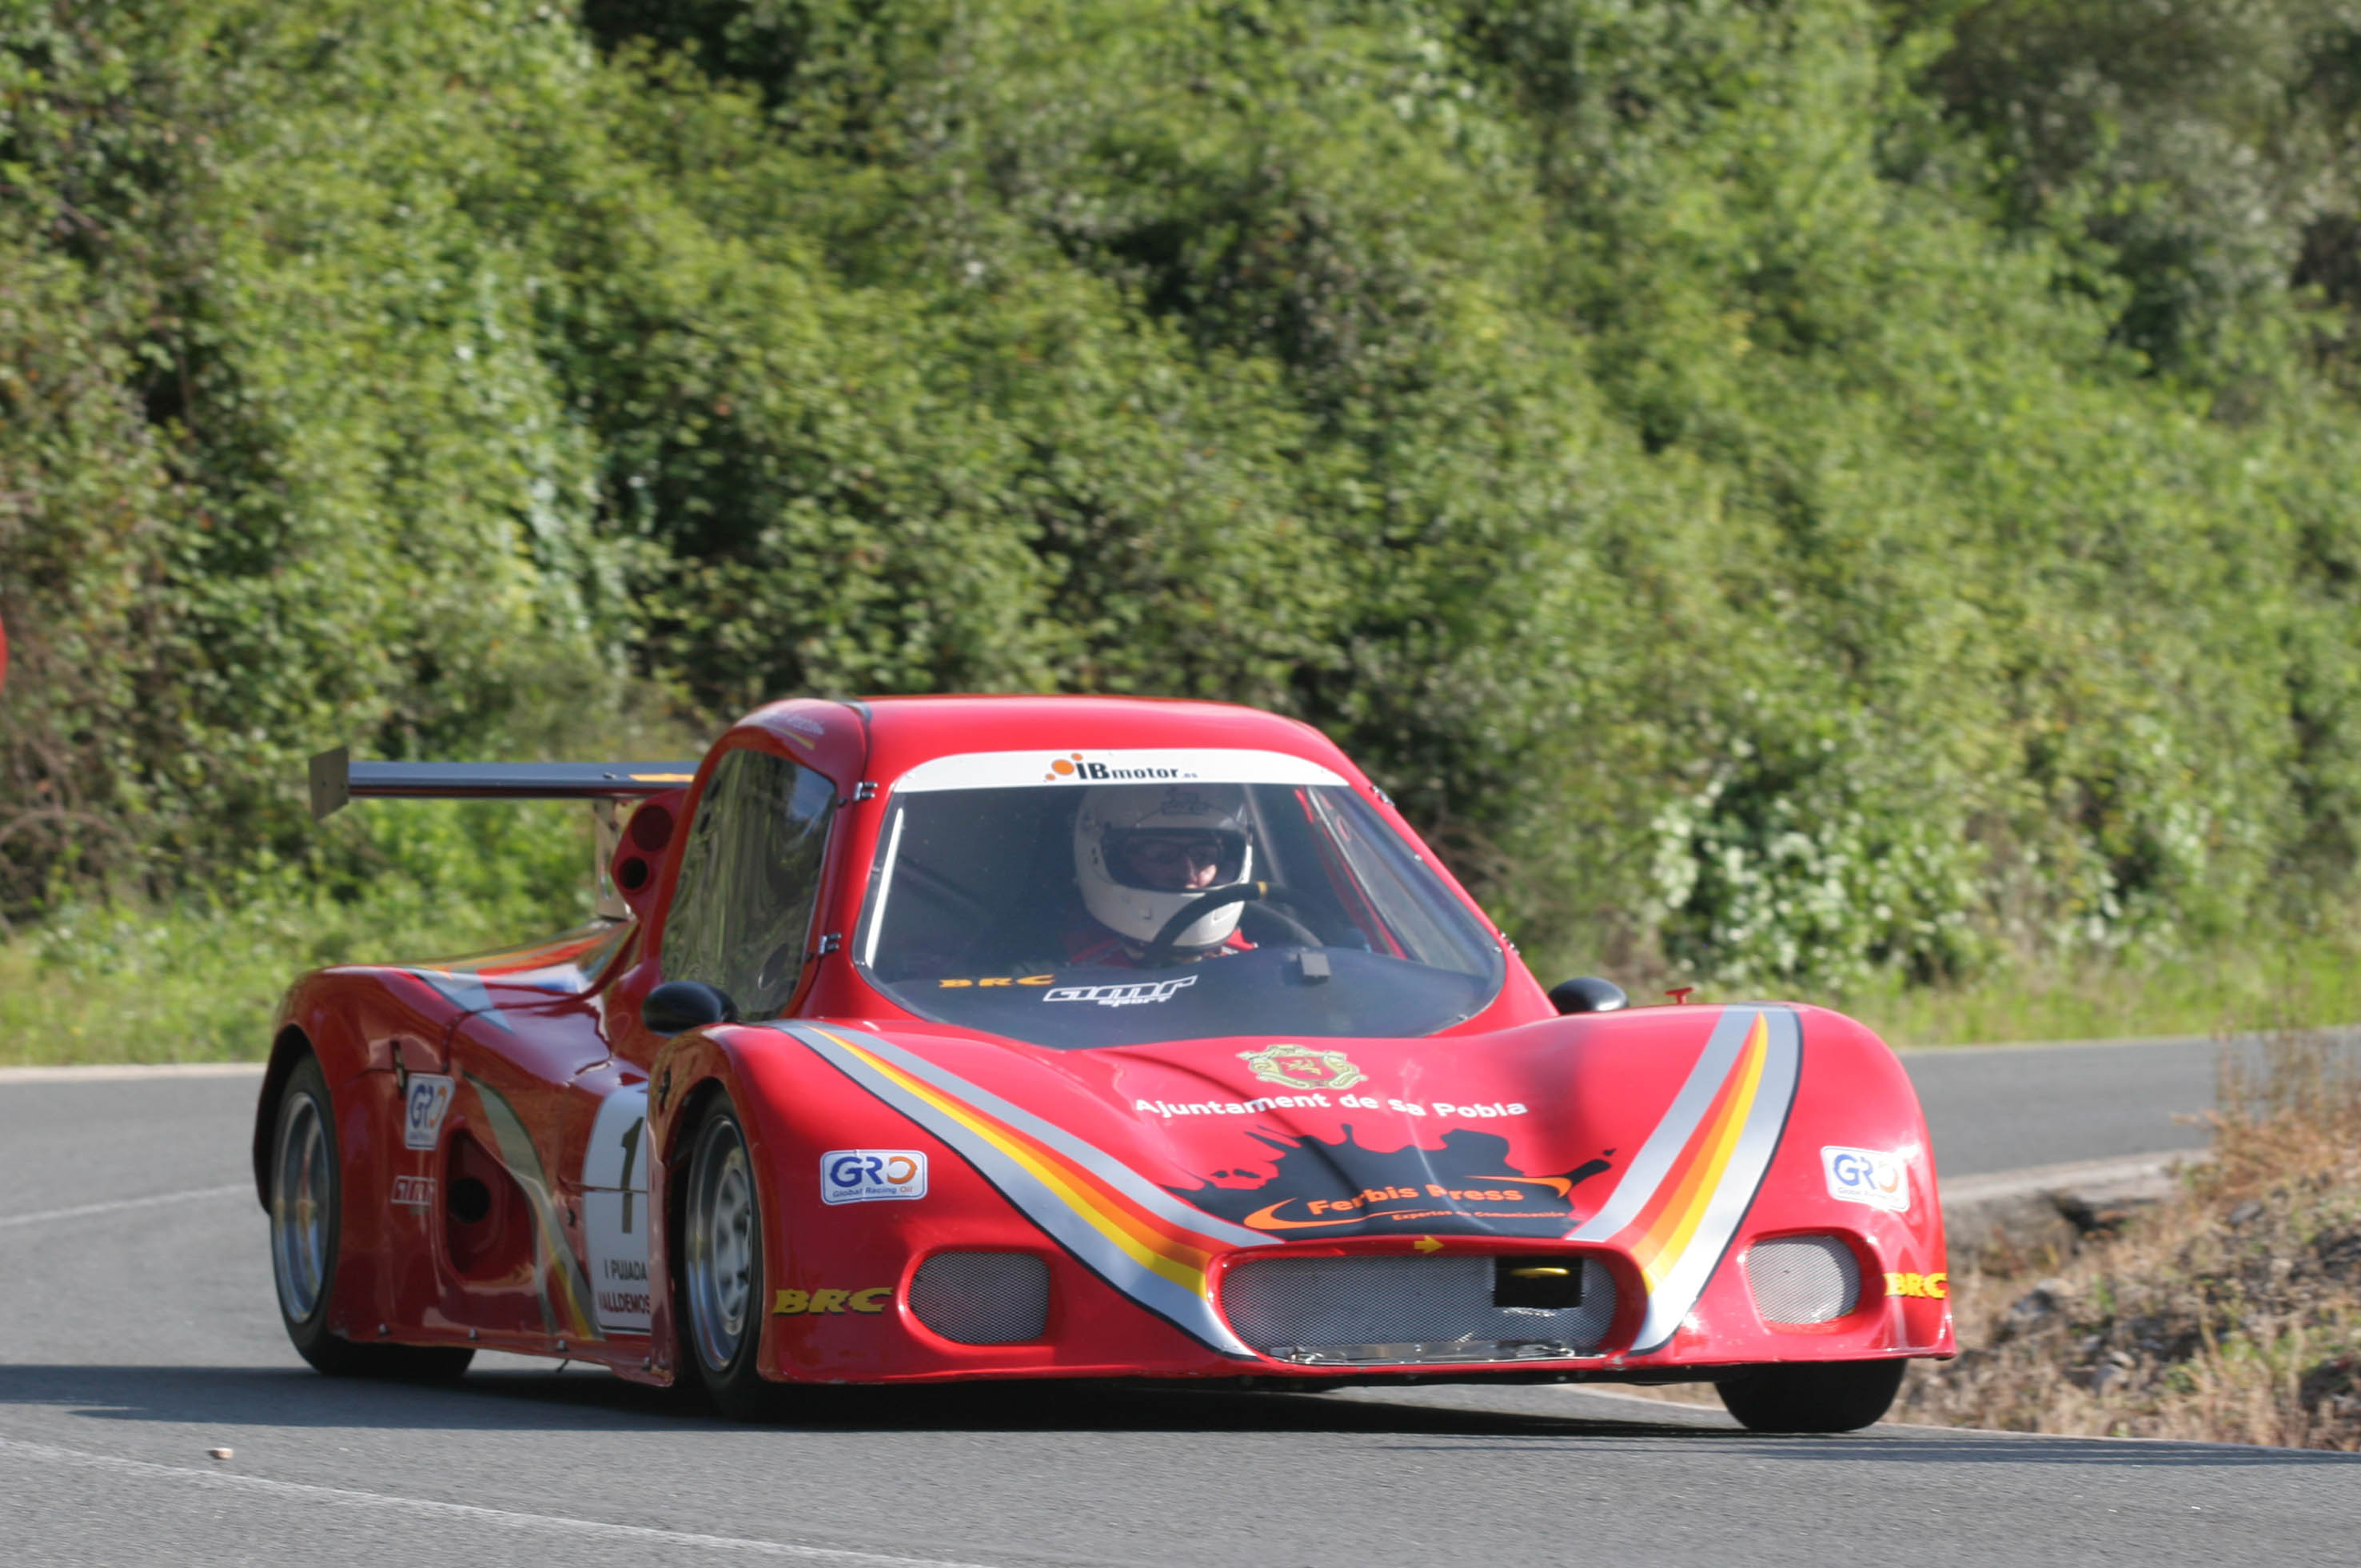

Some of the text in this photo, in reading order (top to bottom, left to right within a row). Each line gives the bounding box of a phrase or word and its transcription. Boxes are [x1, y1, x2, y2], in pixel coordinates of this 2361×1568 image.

[939, 974, 1057, 988] BRC
[1135, 1092, 1529, 1119] Ajuntament de sa Pobla
[620, 1116, 644, 1235] 1
[832, 1188, 863, 1198] Global
[1306, 1183, 1525, 1215] Ferbis Press
[1391, 1210, 1453, 1222] Expertos
[610, 1258, 648, 1282] PUJADA
[1882, 1271, 1948, 1300] BRC
[772, 1287, 894, 1316] BRC
